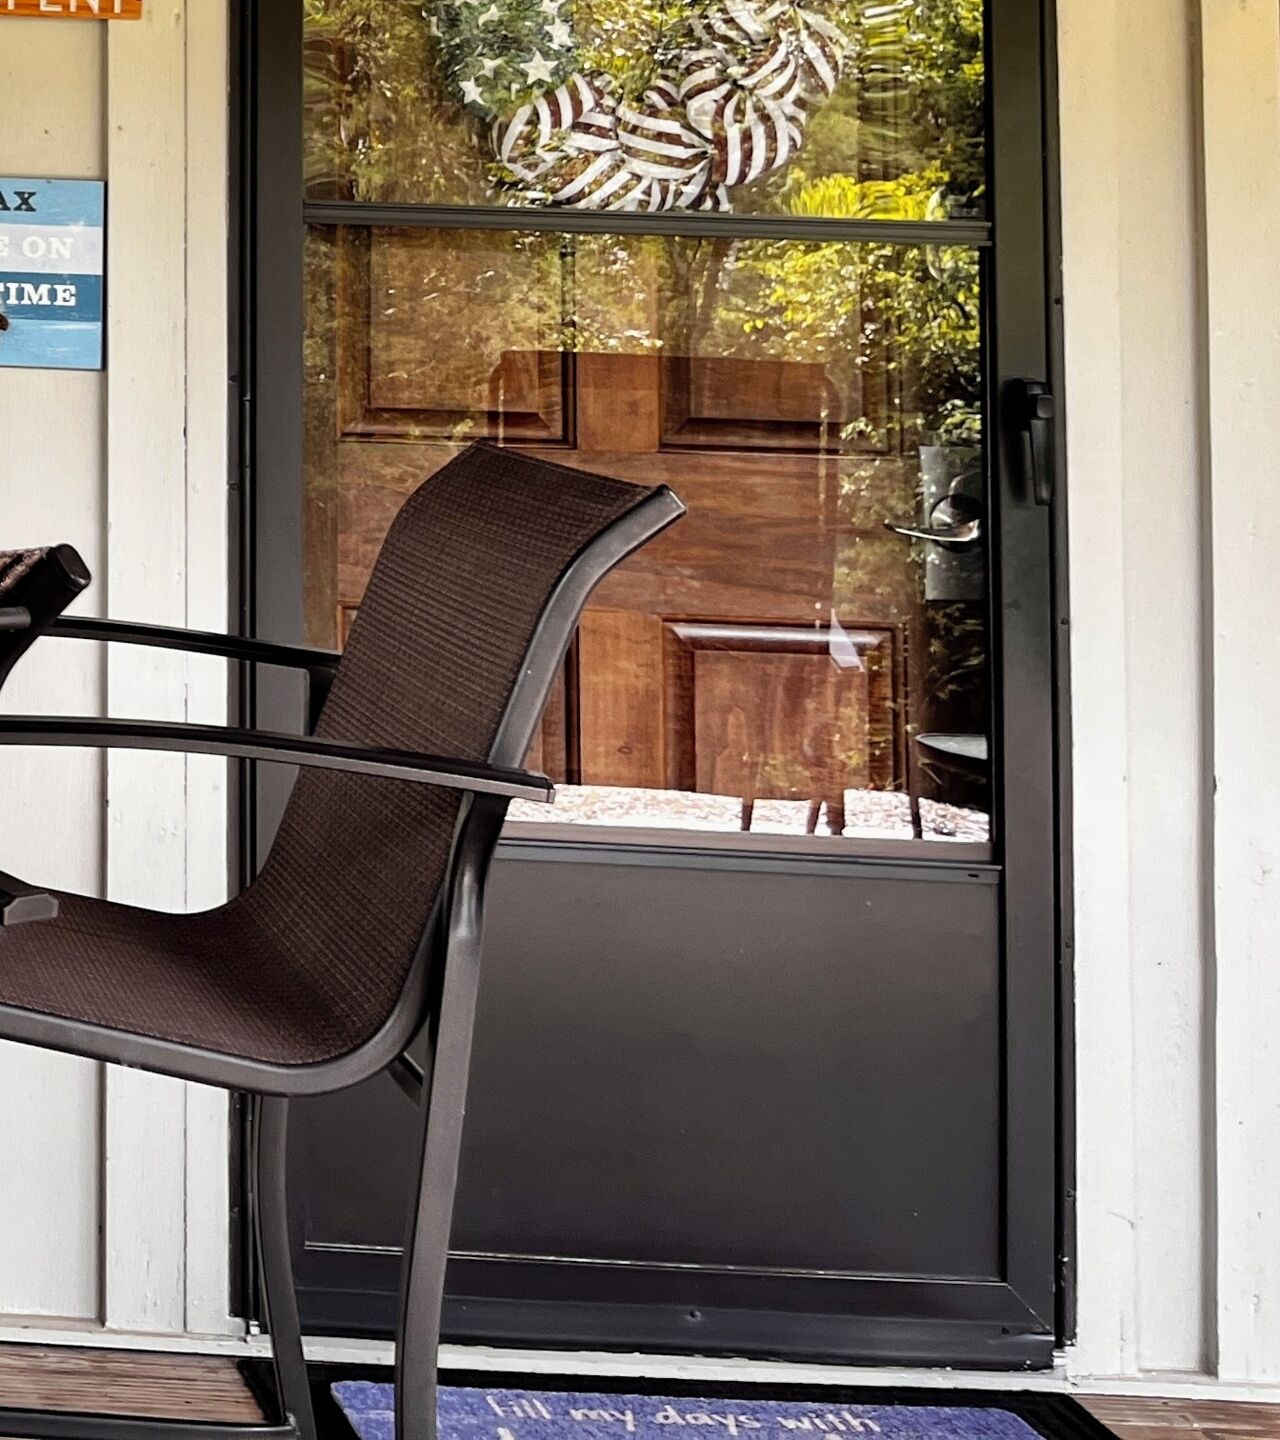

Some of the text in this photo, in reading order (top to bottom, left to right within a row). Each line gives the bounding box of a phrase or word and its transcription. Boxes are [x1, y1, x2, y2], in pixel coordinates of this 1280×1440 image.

[21, 235, 75, 260] ON
[569, 1409, 636, 1432] my
[654, 1404, 762, 1436] days
[776, 1410, 882, 1433] with
